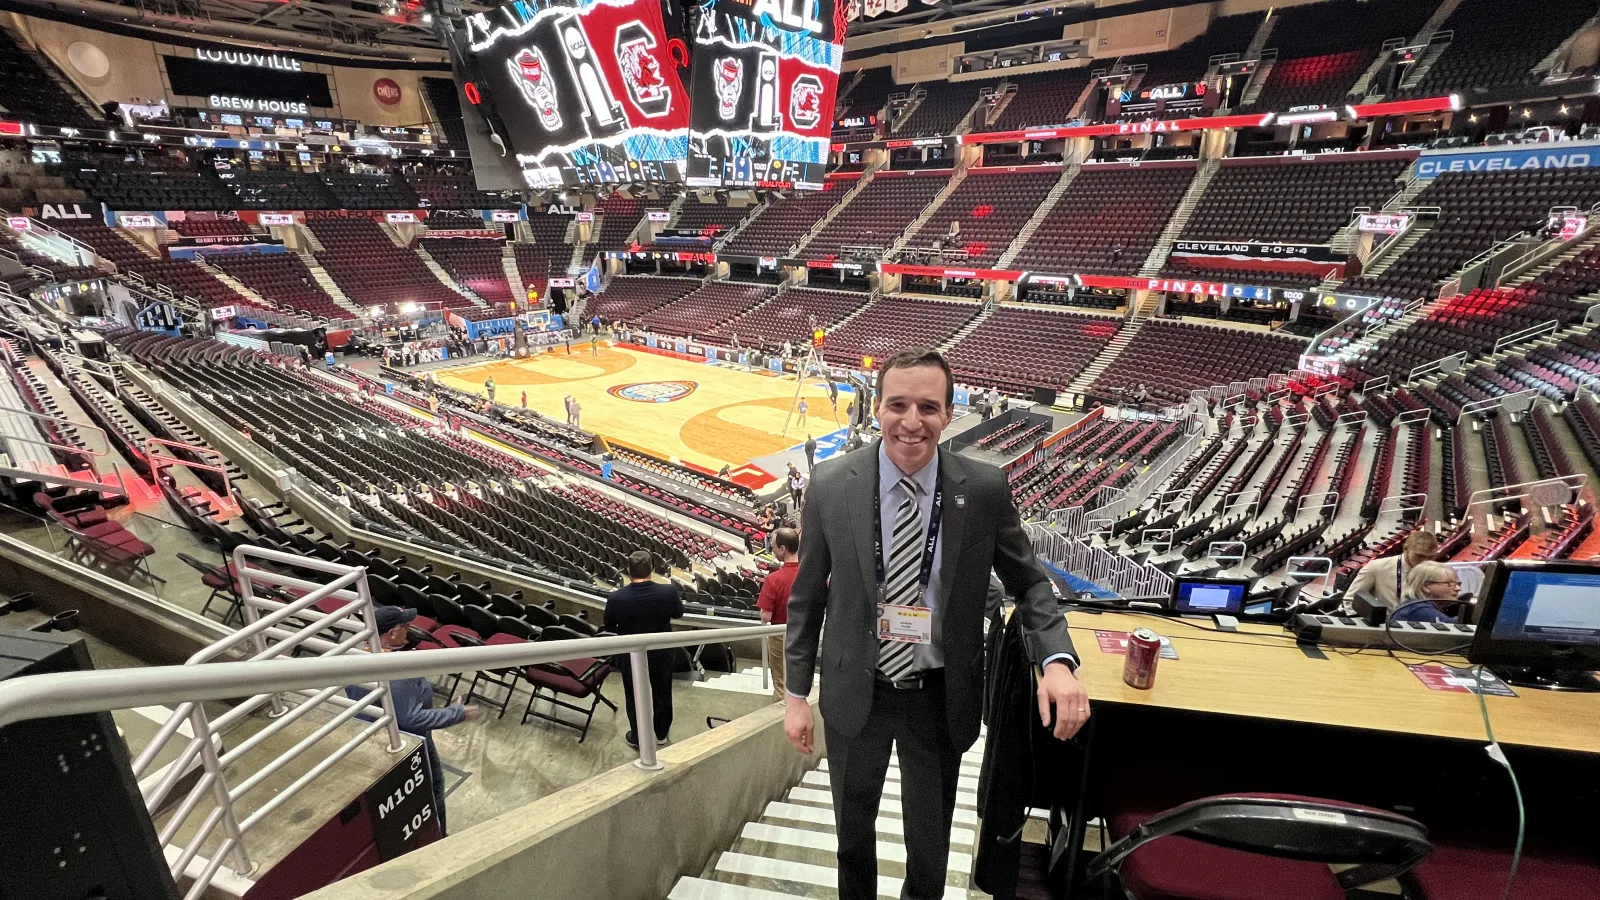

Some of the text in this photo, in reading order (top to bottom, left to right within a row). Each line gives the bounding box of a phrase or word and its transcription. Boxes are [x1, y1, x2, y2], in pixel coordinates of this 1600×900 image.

[196, 48, 302, 71] LOUDVILLE
[210, 95, 308, 115] BREW HOUSE
[1418, 153, 1591, 174] CLEVELAND
[42, 203, 92, 219] ALL
[547, 204, 579, 215] ALL
[1176, 243, 1250, 252] CLEVELAND
[927, 535, 935, 553] ALL
[378, 768, 425, 820] M105
[402, 803, 432, 841] 105
